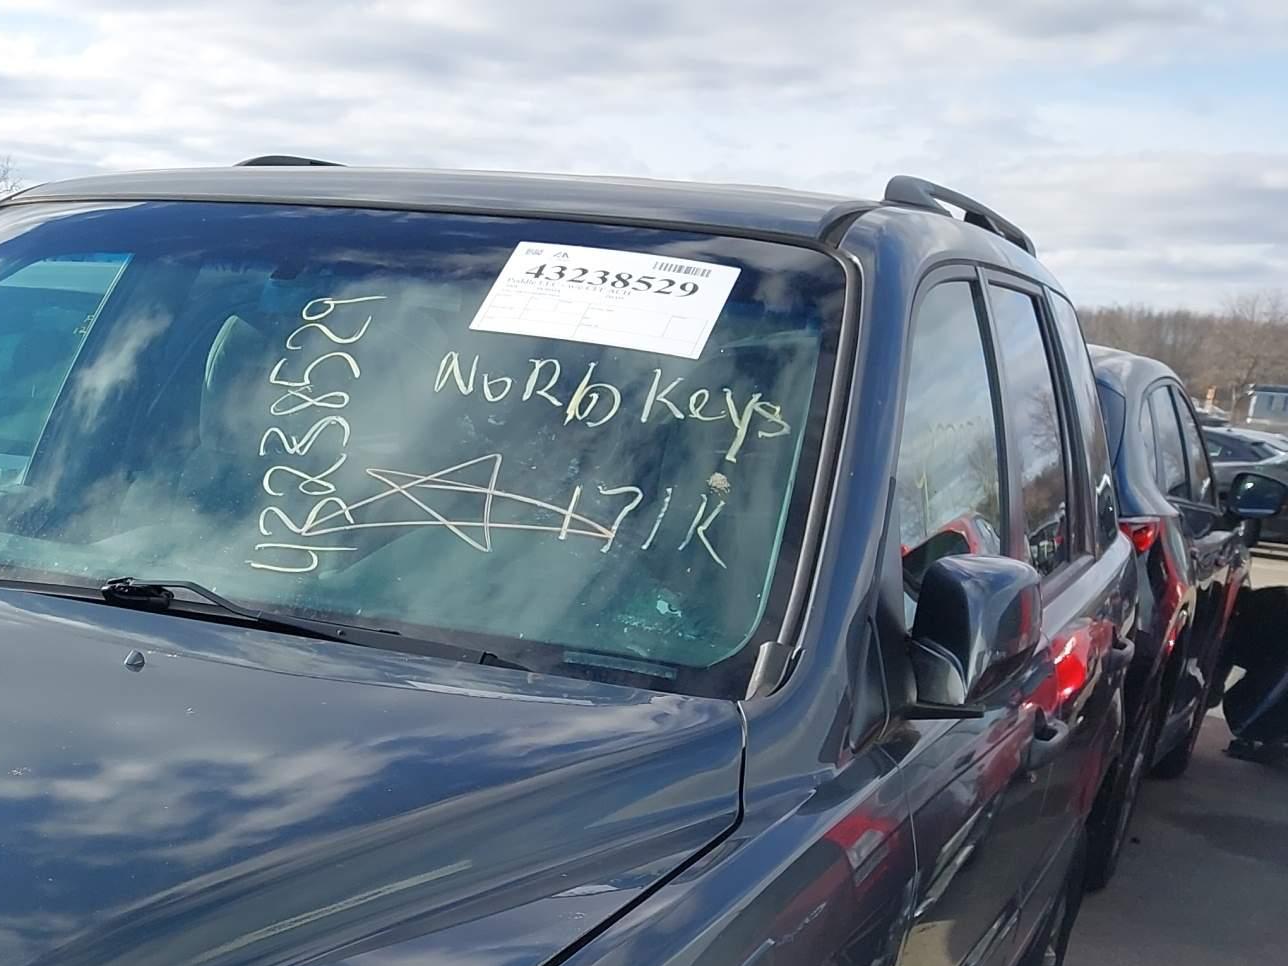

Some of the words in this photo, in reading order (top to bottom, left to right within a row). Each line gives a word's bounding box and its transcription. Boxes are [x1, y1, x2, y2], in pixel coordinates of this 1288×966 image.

[525, 263, 700, 297] 43238529
[245, 295, 388, 573] 43238529
[639, 368, 791, 463] Keys
